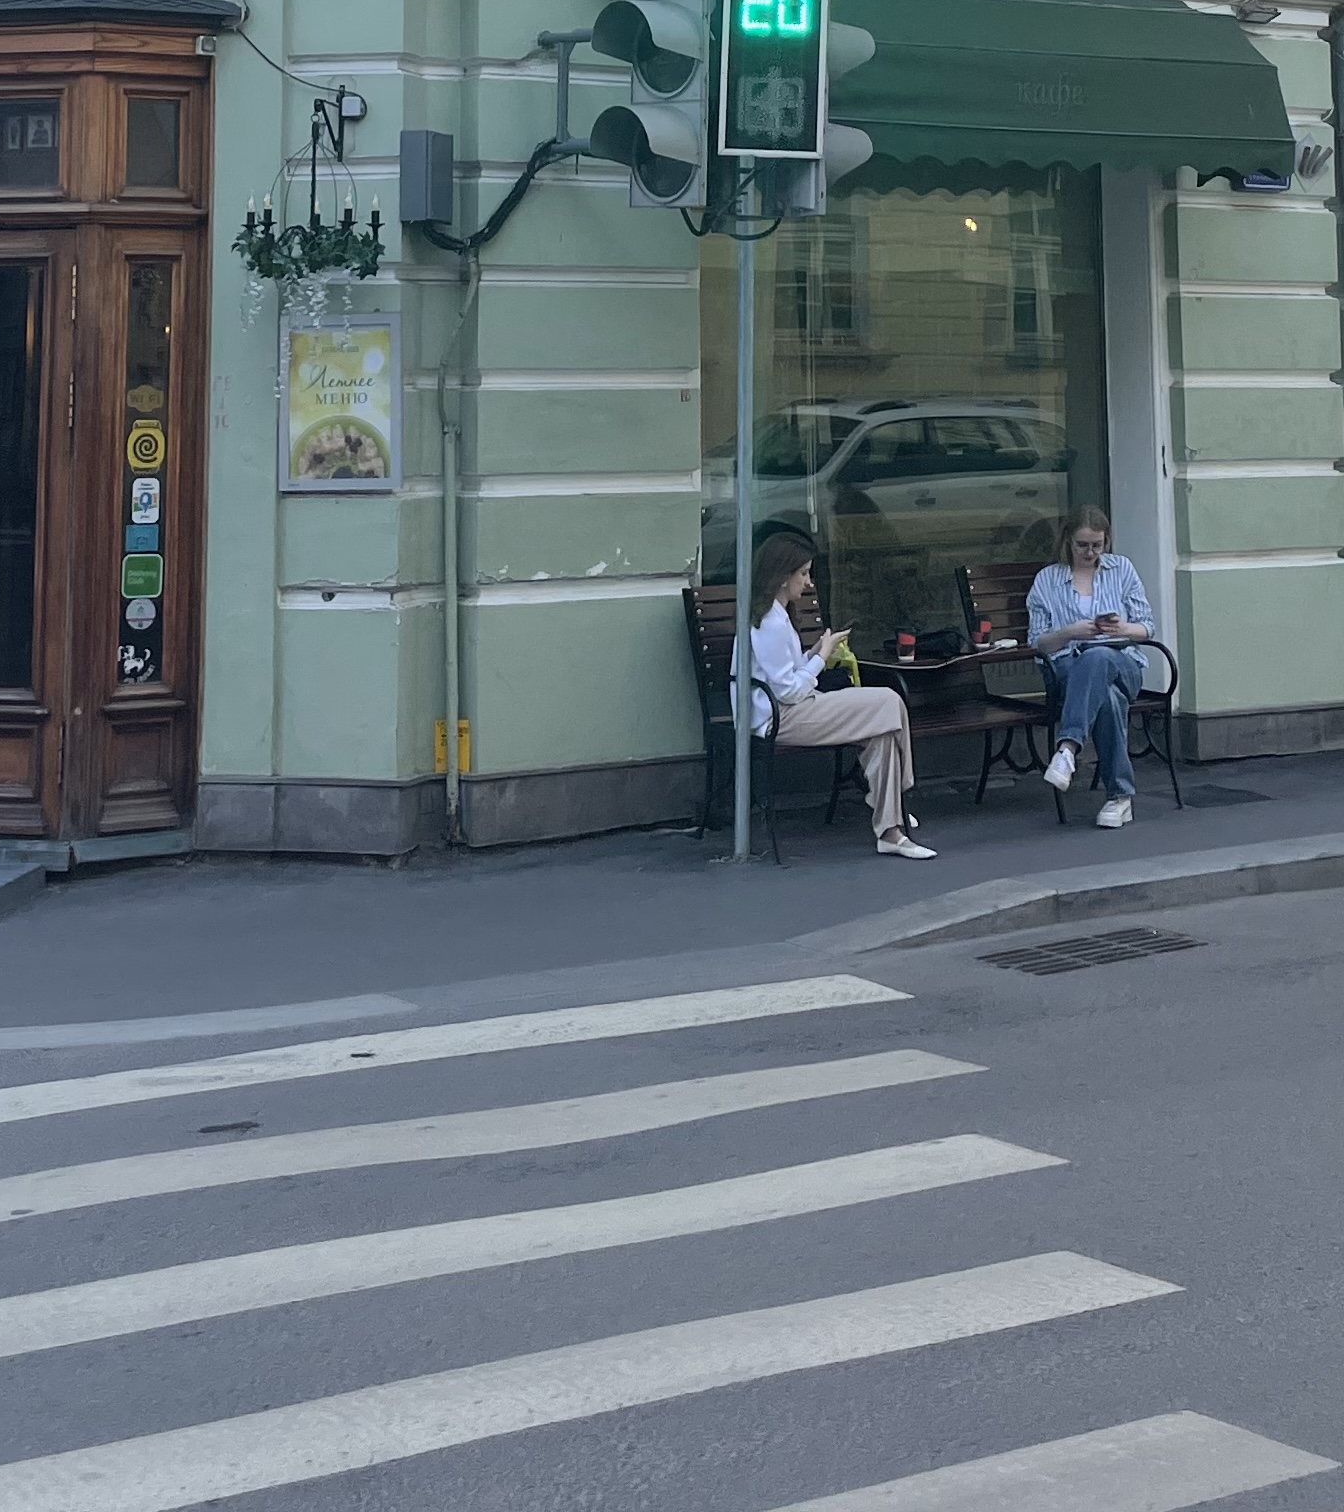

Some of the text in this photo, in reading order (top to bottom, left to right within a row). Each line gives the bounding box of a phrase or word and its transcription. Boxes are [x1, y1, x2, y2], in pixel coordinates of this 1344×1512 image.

[1017, 71, 1085, 115] кафе
[299, 365, 376, 393] Летнее
[315, 392, 369, 406] МЕНЮ
